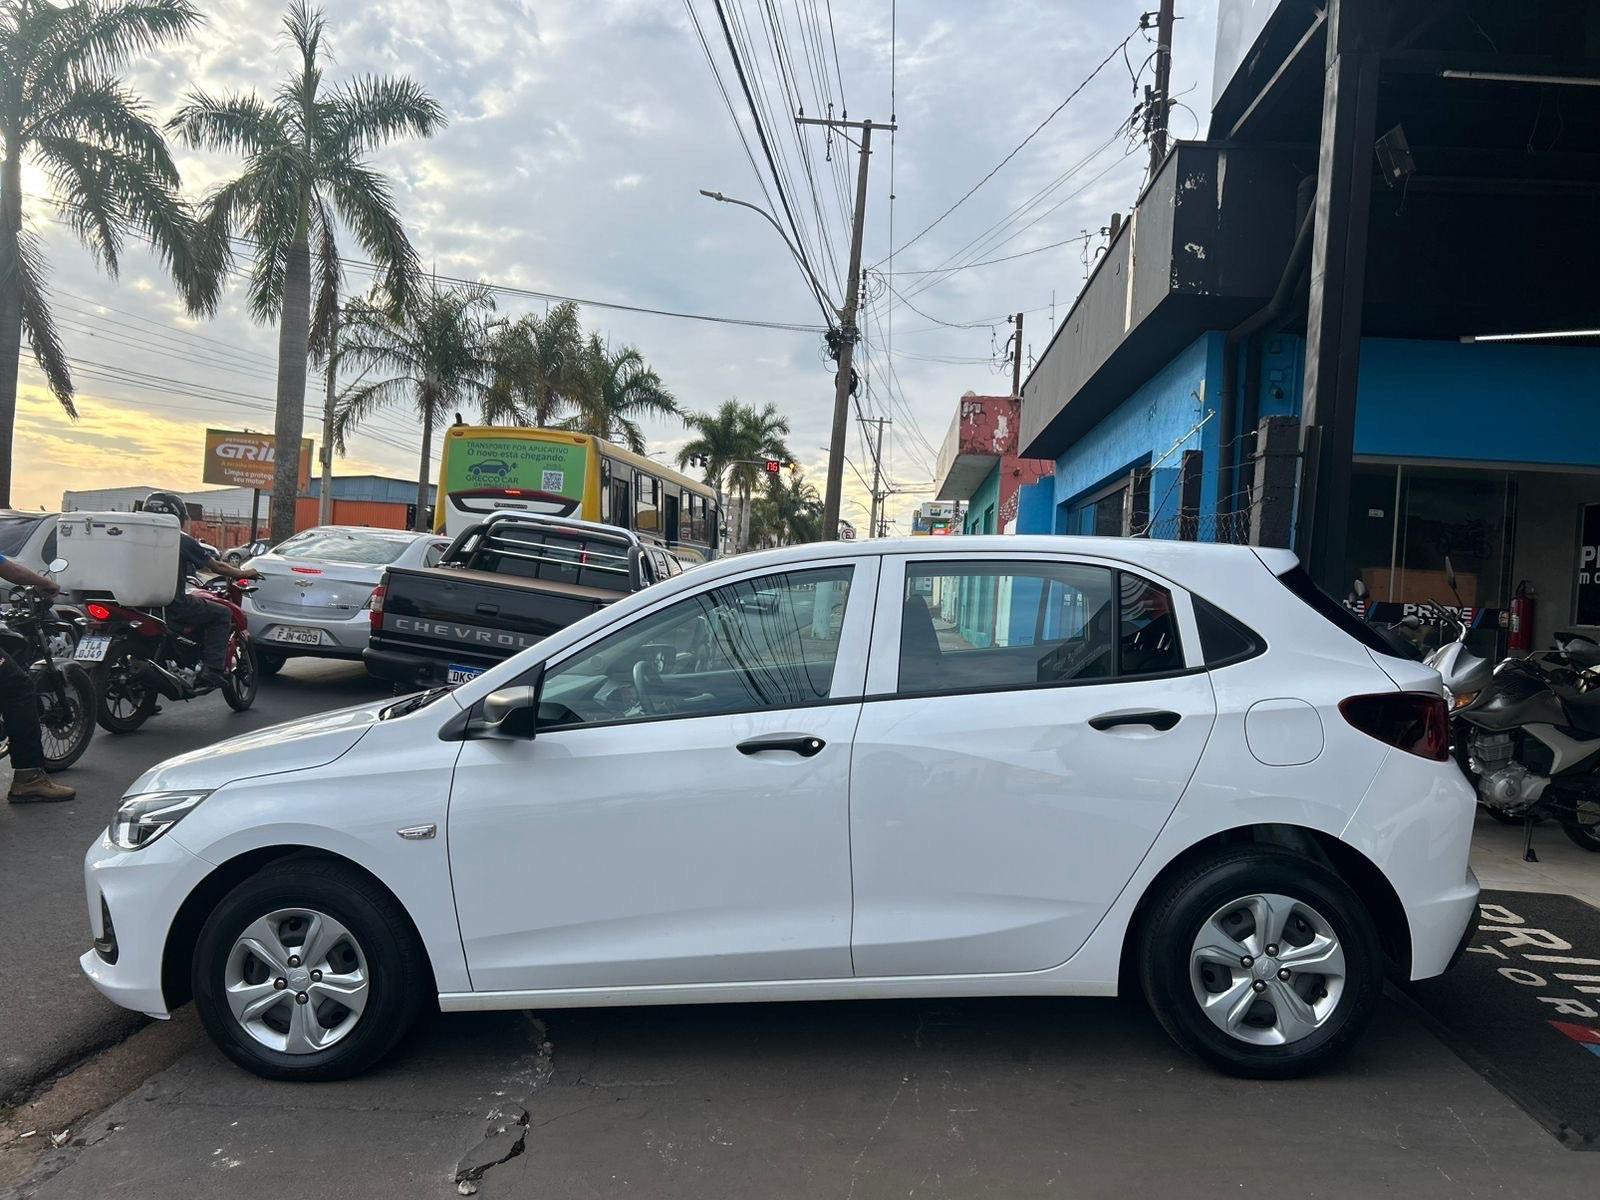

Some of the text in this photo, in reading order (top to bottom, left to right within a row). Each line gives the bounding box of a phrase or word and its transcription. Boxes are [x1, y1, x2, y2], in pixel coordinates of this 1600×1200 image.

[466, 442, 509, 451] TRANSPORTE
[529, 446, 569, 455] APLICATIVO
[467, 448, 474, 456] O
[520, 452, 566, 462] chegando.
[224, 468, 244, 477] Limpa
[245, 477, 265, 485] motor
[465, 474, 519, 484] GRECCO CAR
[277, 631, 318, 643] FJN-4009
[396, 619, 530, 648] CHEVROL
[85, 641, 102, 650] TLA
